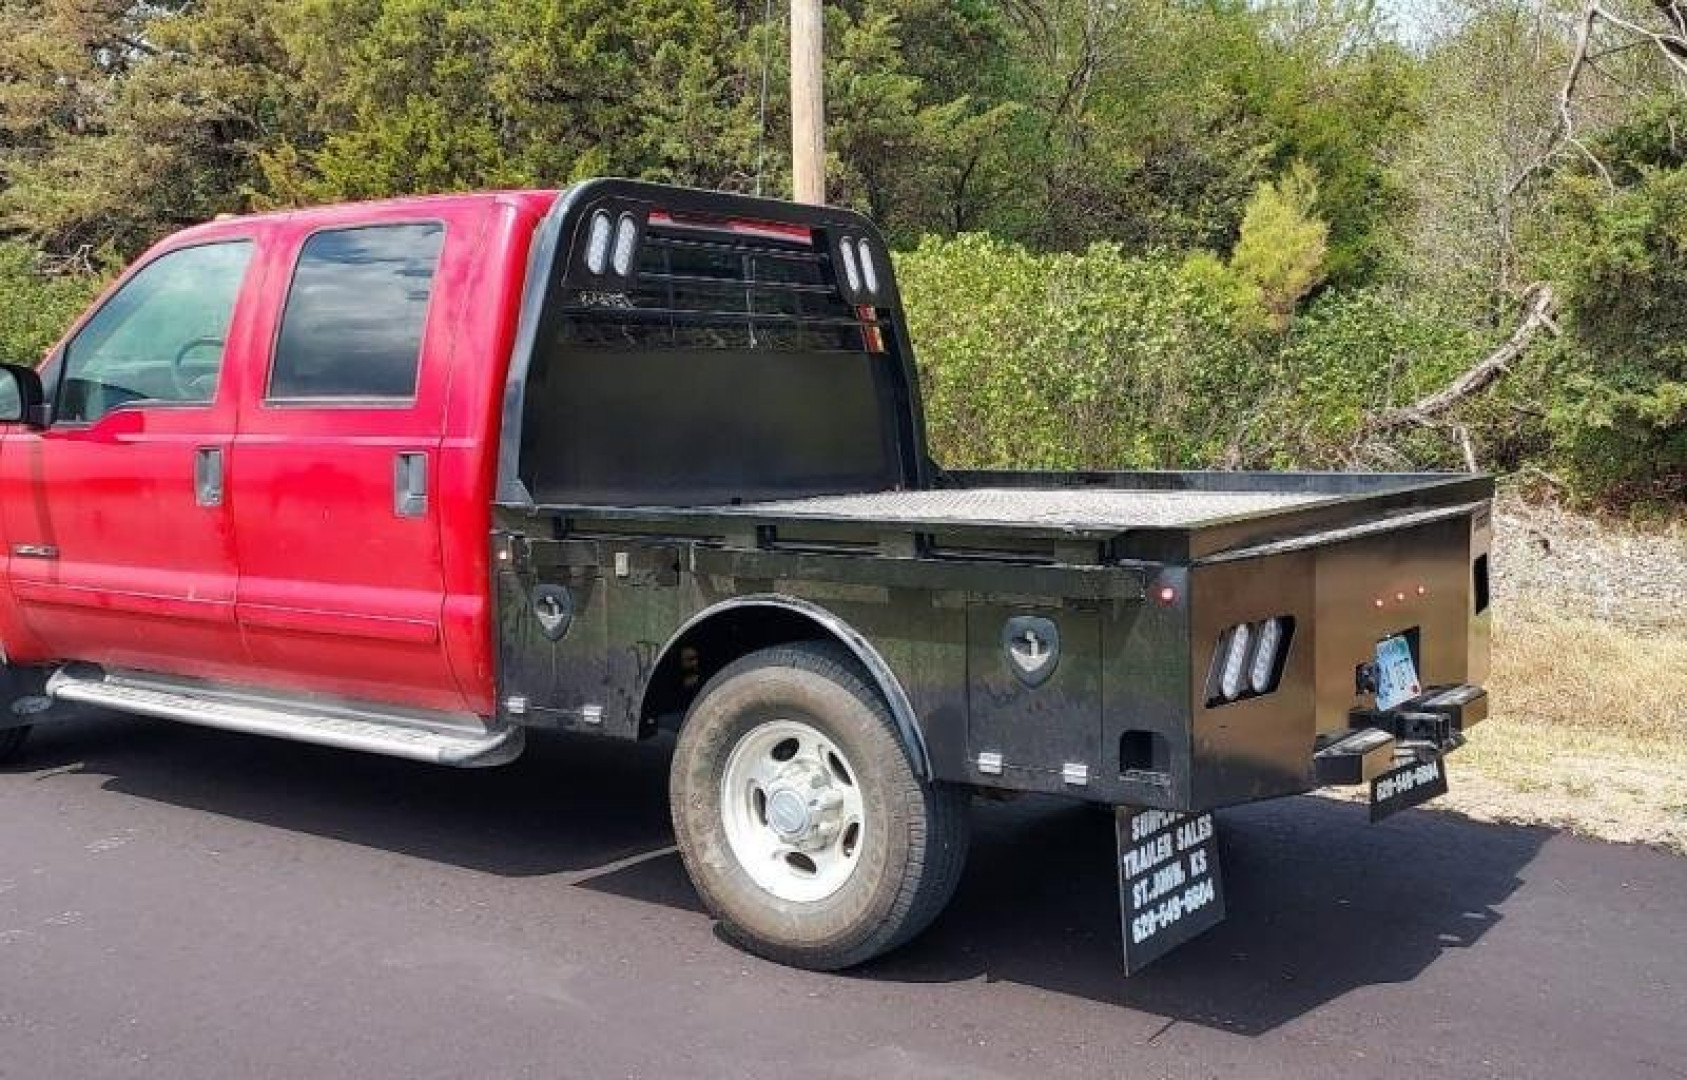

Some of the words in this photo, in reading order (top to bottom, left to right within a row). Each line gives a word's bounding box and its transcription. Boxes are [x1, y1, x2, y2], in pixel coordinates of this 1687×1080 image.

[1123, 832, 1173, 880] TRAILER
[1176, 813, 1213, 851] SALES
[1190, 848, 1207, 879] KS
